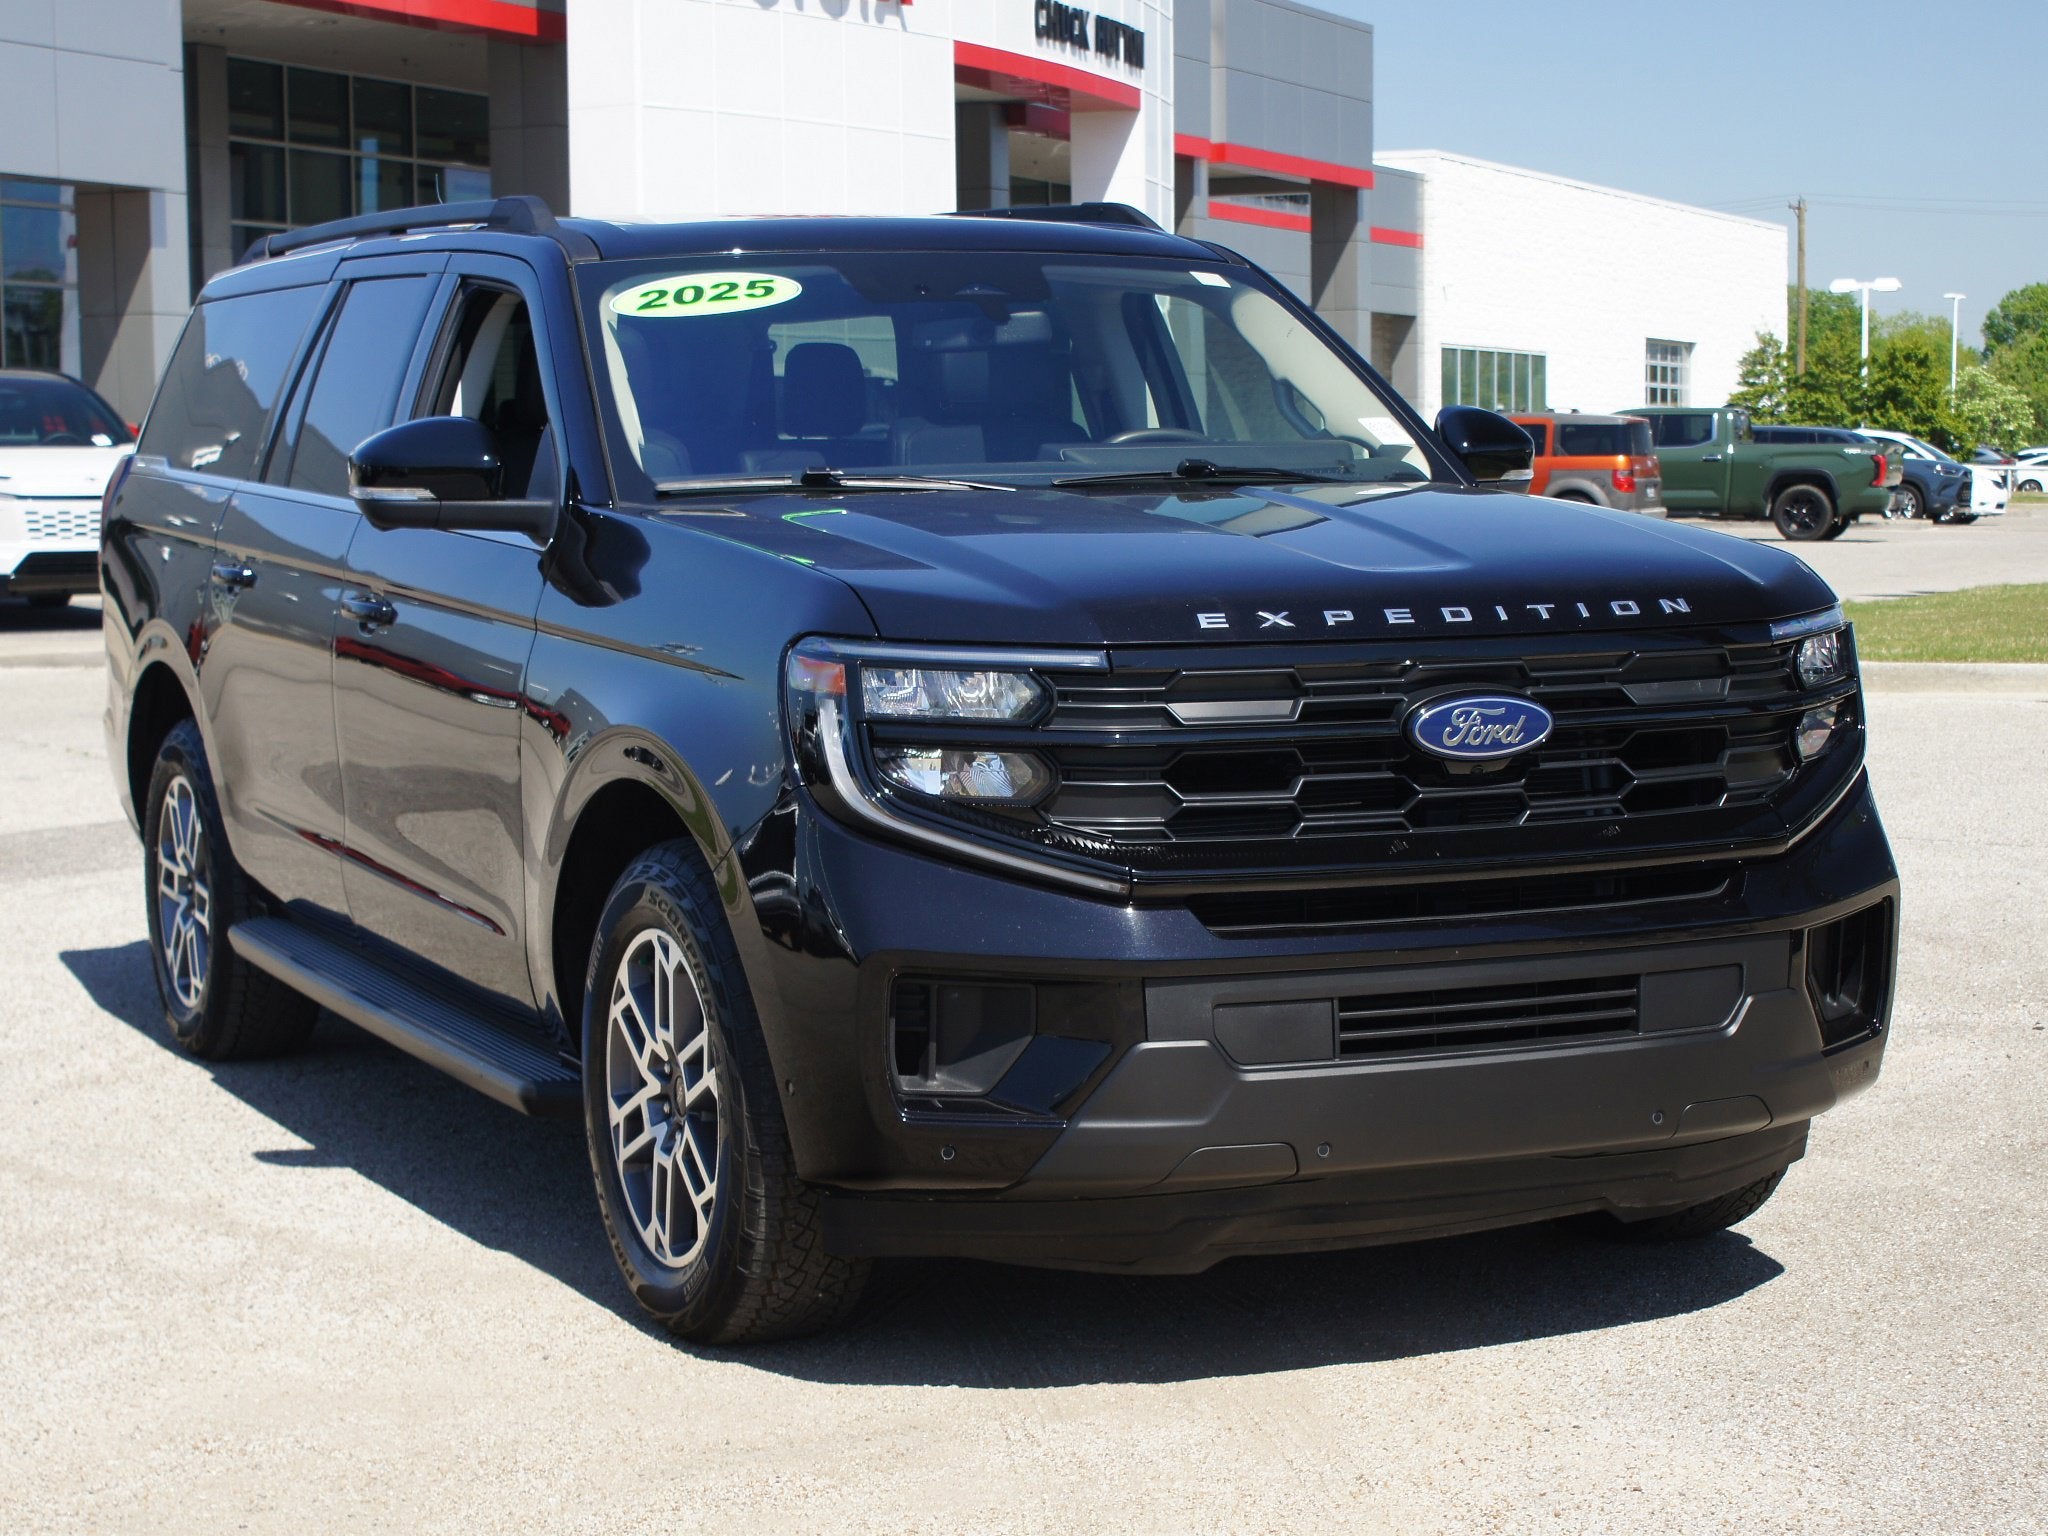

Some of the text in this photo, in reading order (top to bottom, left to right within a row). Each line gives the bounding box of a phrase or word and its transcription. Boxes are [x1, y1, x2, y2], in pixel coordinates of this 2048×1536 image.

[1035, 0, 1090, 51] CHUCK
[637, 279, 775, 311] 2025
[1197, 598, 1692, 628] EXPEDITION
[1442, 707, 1526, 747] Ford
[648, 888, 716, 1024] SCORPION
